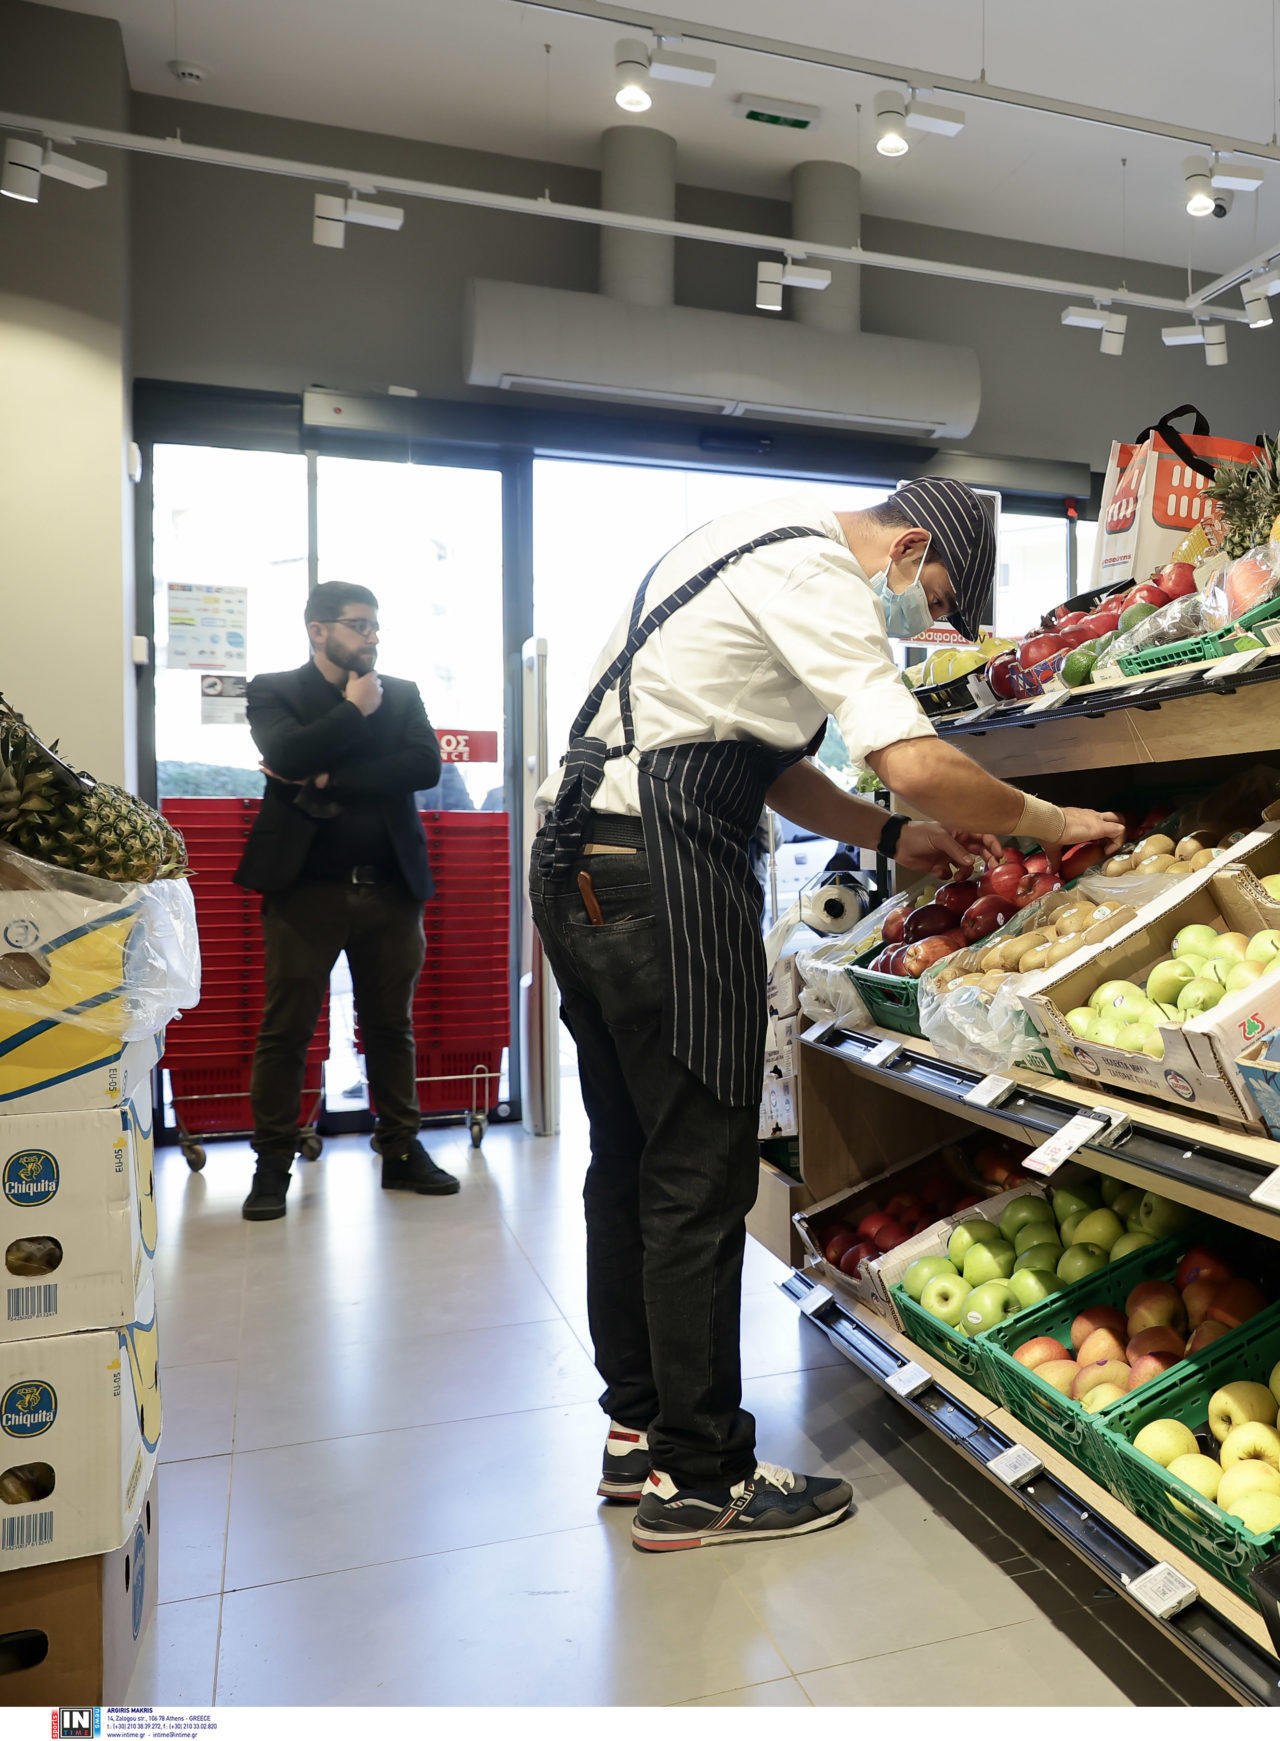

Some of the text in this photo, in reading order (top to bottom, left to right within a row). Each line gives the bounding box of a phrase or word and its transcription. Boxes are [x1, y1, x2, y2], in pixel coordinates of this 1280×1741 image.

[109, 1068, 117, 1092] EU-05
[115, 1148, 123, 1173] EU-05
[5, 1179, 57, 1197] Chiquita
[113, 1371, 121, 1397] EU-05
[2, 1409, 55, 1429] Chiquita
